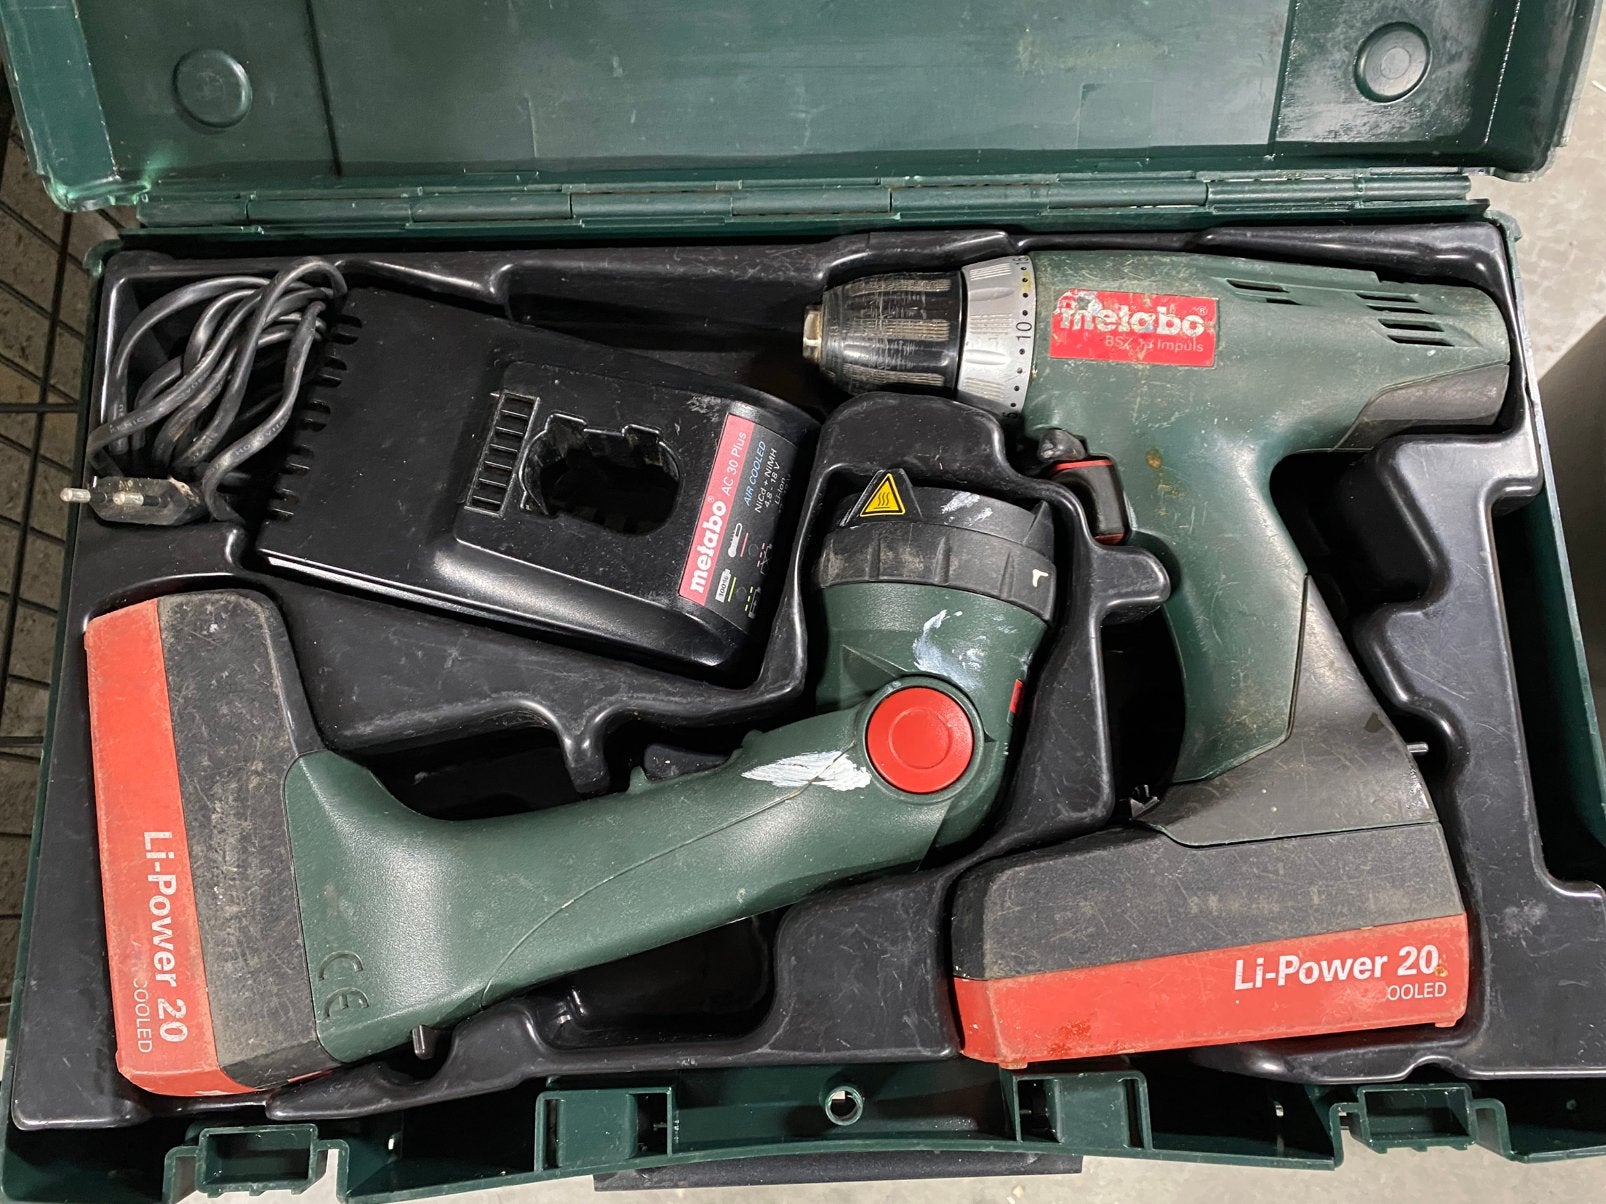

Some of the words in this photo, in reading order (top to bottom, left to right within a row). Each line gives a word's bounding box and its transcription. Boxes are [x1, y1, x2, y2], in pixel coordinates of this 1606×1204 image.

[1015, 321, 1032, 341] 10
[1060, 303, 1205, 337] metabo
[1157, 338, 1204, 353] Impuls
[731, 432, 747, 458] Plus
[727, 460, 738, 476] 30
[743, 486, 754, 507] AIR
[749, 441, 766, 485] COOLED
[771, 471, 778, 483] 18
[773, 461, 780, 470] V
[721, 476, 734, 496] AC
[690, 500, 727, 593] metabo
[144, 831, 177, 987] Li-Power
[1234, 954, 1388, 990] Li-Power
[1397, 944, 1439, 977] 20
[157, 998, 188, 1042] 20
